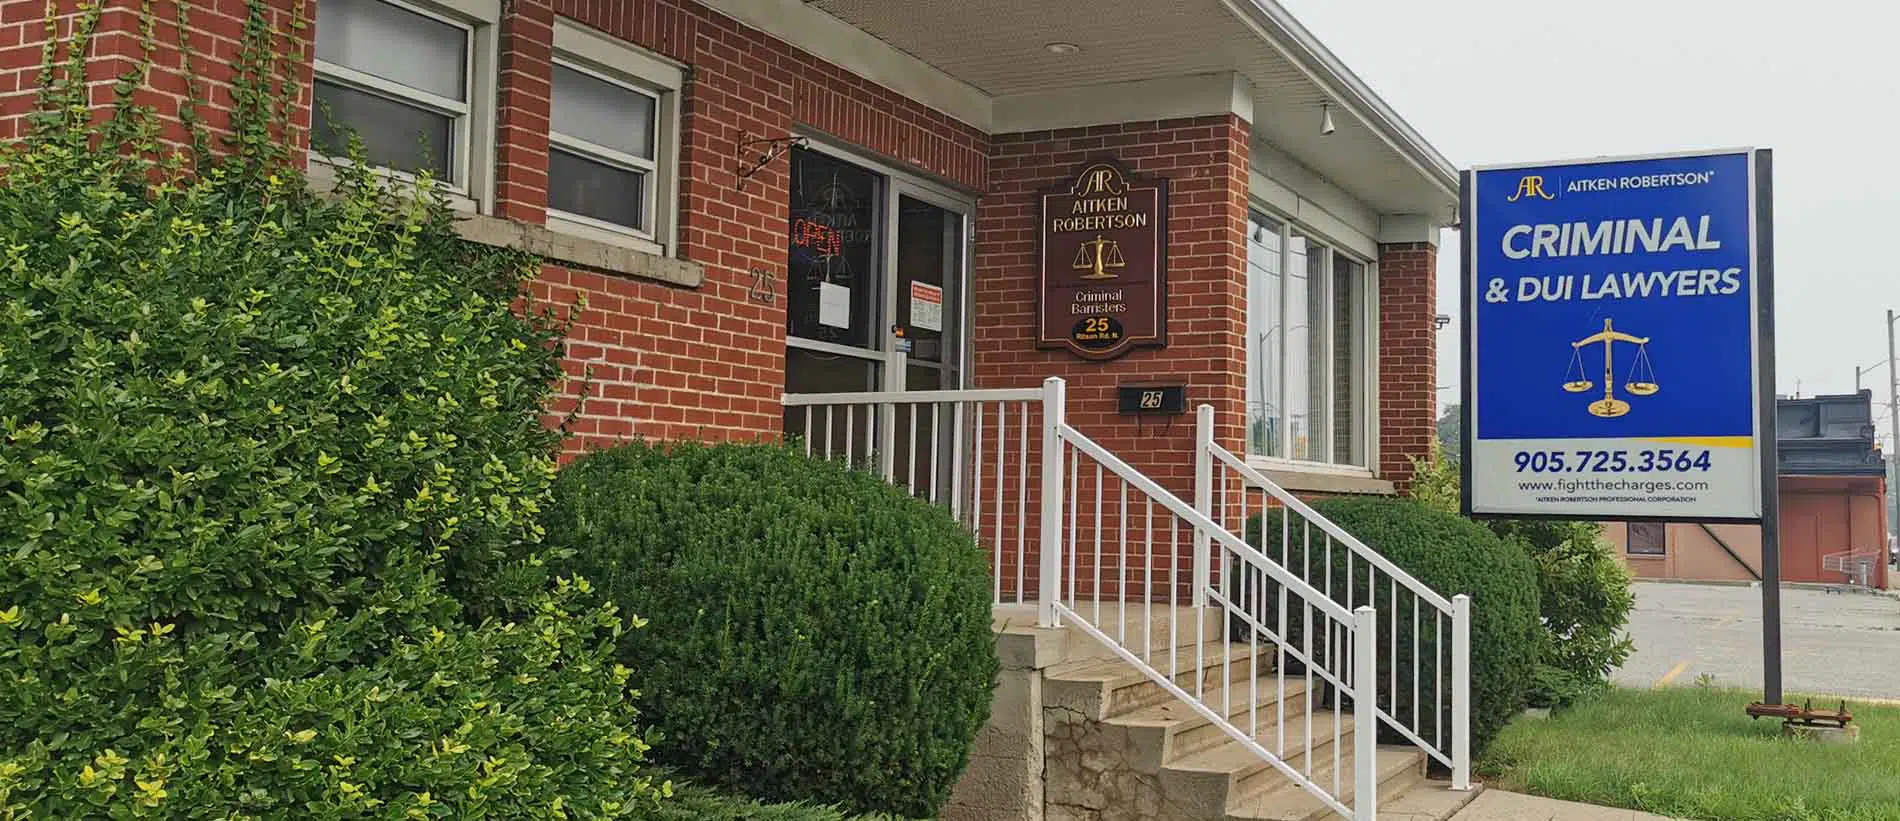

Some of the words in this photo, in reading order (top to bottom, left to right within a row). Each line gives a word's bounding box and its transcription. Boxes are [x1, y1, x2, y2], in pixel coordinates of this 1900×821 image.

[1567, 178, 1616, 193] AITKEN
[1072, 197, 1128, 214] AITKEN
[1053, 213, 1147, 233] ROBERTSON
[793, 217, 841, 256] OPEN
[1502, 215, 1721, 260] CRIMINAL
[751, 266, 776, 304] 25
[1485, 277, 1508, 303] &
[1517, 275, 1573, 302] DUI
[1581, 267, 1741, 300] LAWYERS
[1076, 289, 1123, 302] Criminal
[1071, 302, 1127, 315] Barristers
[1086, 318, 1109, 332] 25
[1142, 391, 1162, 408] 25
[1514, 450, 1712, 473] 905.725.3564
[1518, 478, 1709, 493] www.fightthecharges.com
